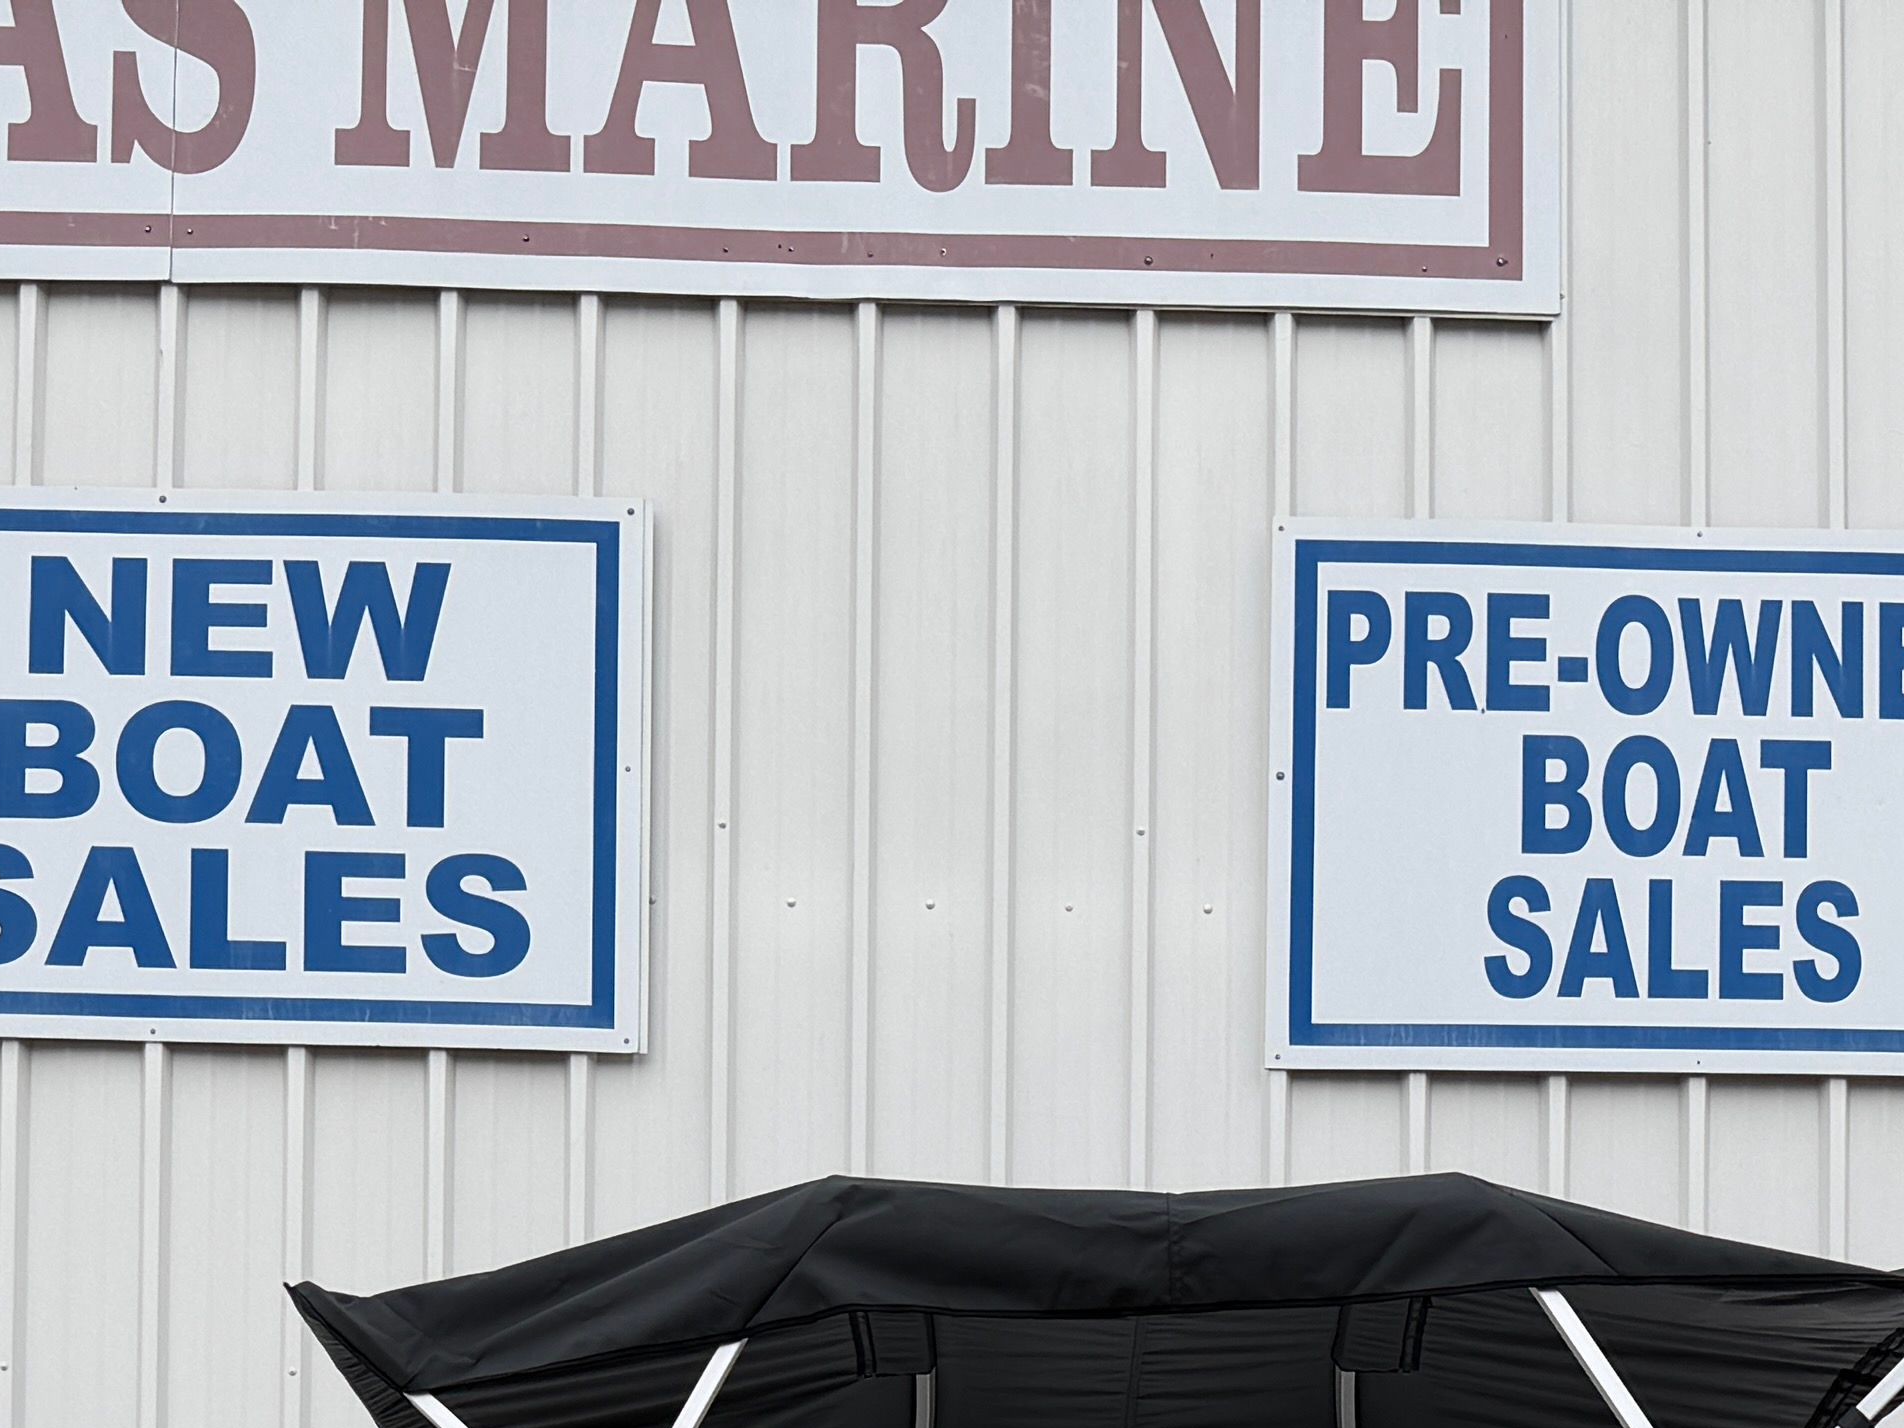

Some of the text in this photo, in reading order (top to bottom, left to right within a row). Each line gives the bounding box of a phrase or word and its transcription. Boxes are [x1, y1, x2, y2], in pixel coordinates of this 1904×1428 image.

[335, 0, 1462, 196] MARINE
[28, 556, 451, 682] NEW
[1521, 735, 1832, 859] BOAT
[1484, 875, 1863, 1003] SALES
